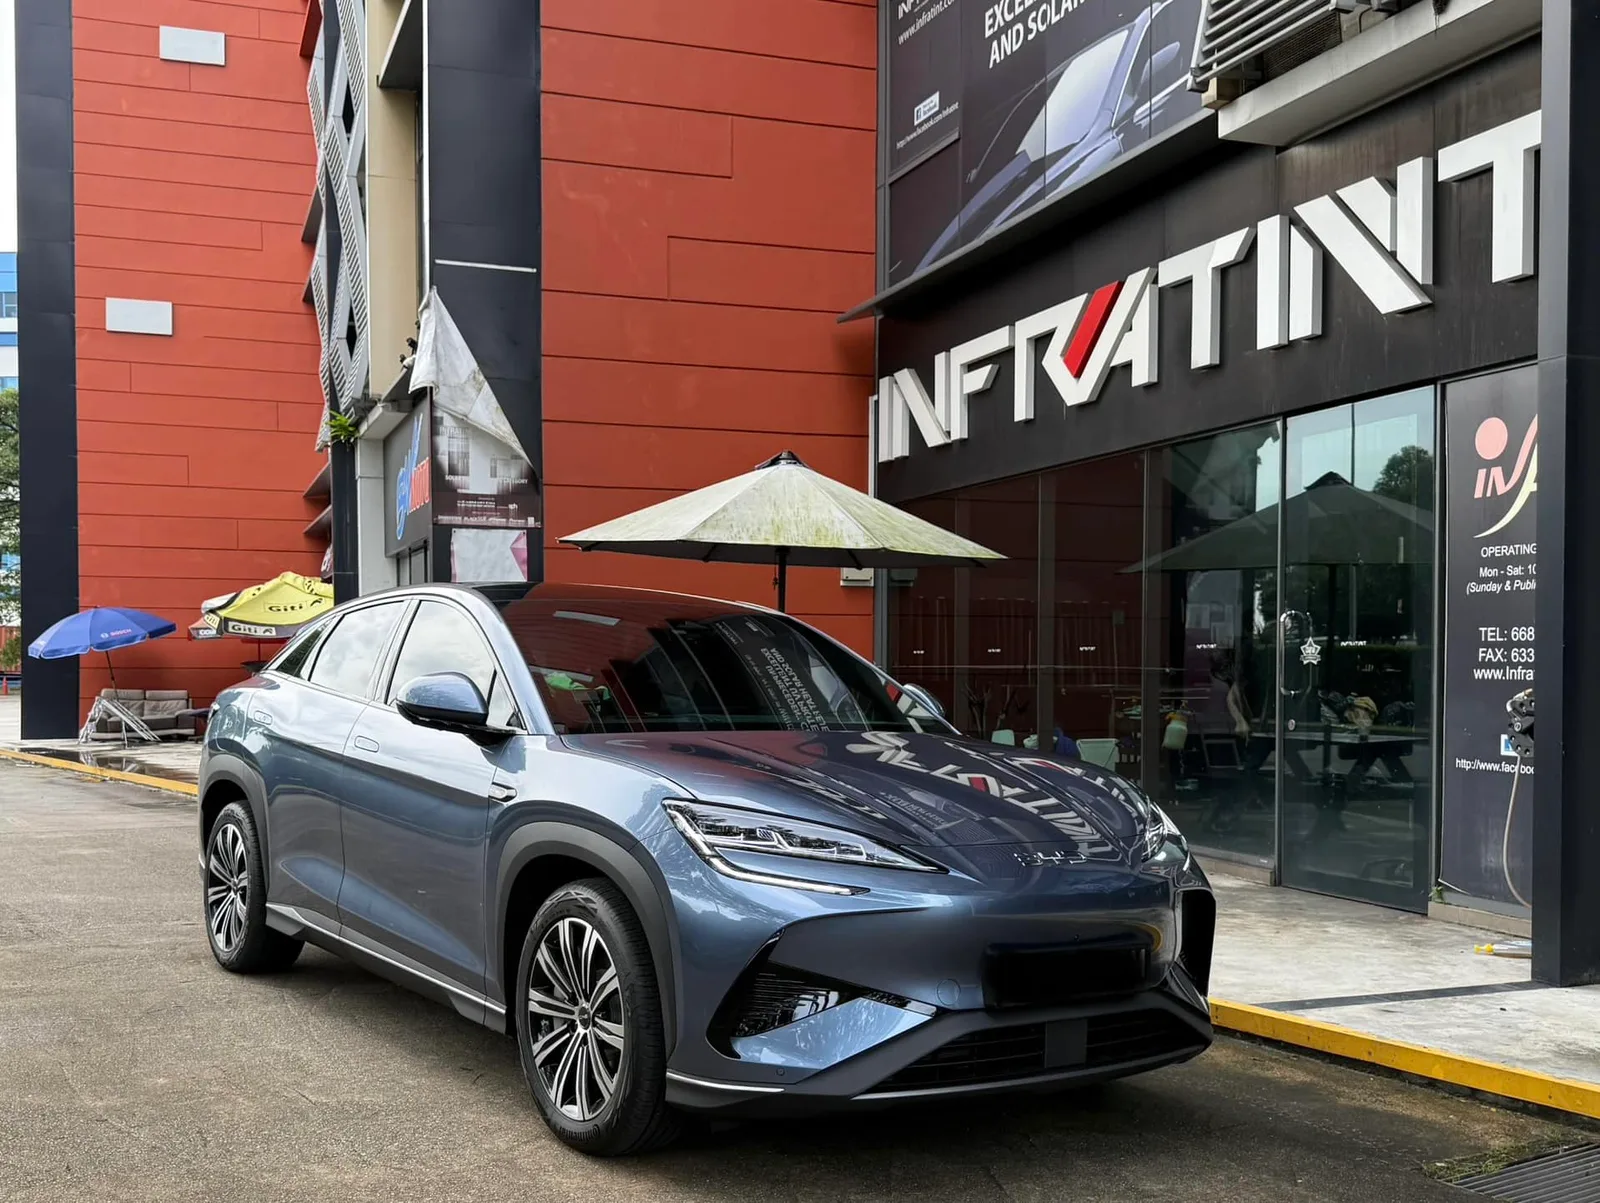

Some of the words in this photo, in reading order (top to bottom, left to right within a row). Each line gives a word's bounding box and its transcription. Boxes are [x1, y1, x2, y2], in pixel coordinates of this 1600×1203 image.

[898, 0, 955, 45] www.infratint.co
[989, 22, 1025, 69] AND
[879, 110, 1542, 463] INFRATINT
[1480, 543, 1537, 558] OPERATING
[1479, 567, 1499, 579] Mon
[1506, 564, 1525, 576] Sat:
[1465, 581, 1503, 595] (Sunday
[1505, 580, 1512, 591] &
[268, 603, 303, 613] Giti
[231, 624, 258, 634] Giti
[1479, 627, 1508, 642] TEL:
[1511, 627, 1535, 642] 668
[1479, 647, 1508, 663] FAX:
[1511, 647, 1535, 663] 633
[1473, 666, 1536, 681] www.Infra
[1455, 757, 1535, 774] http://www.facbo
